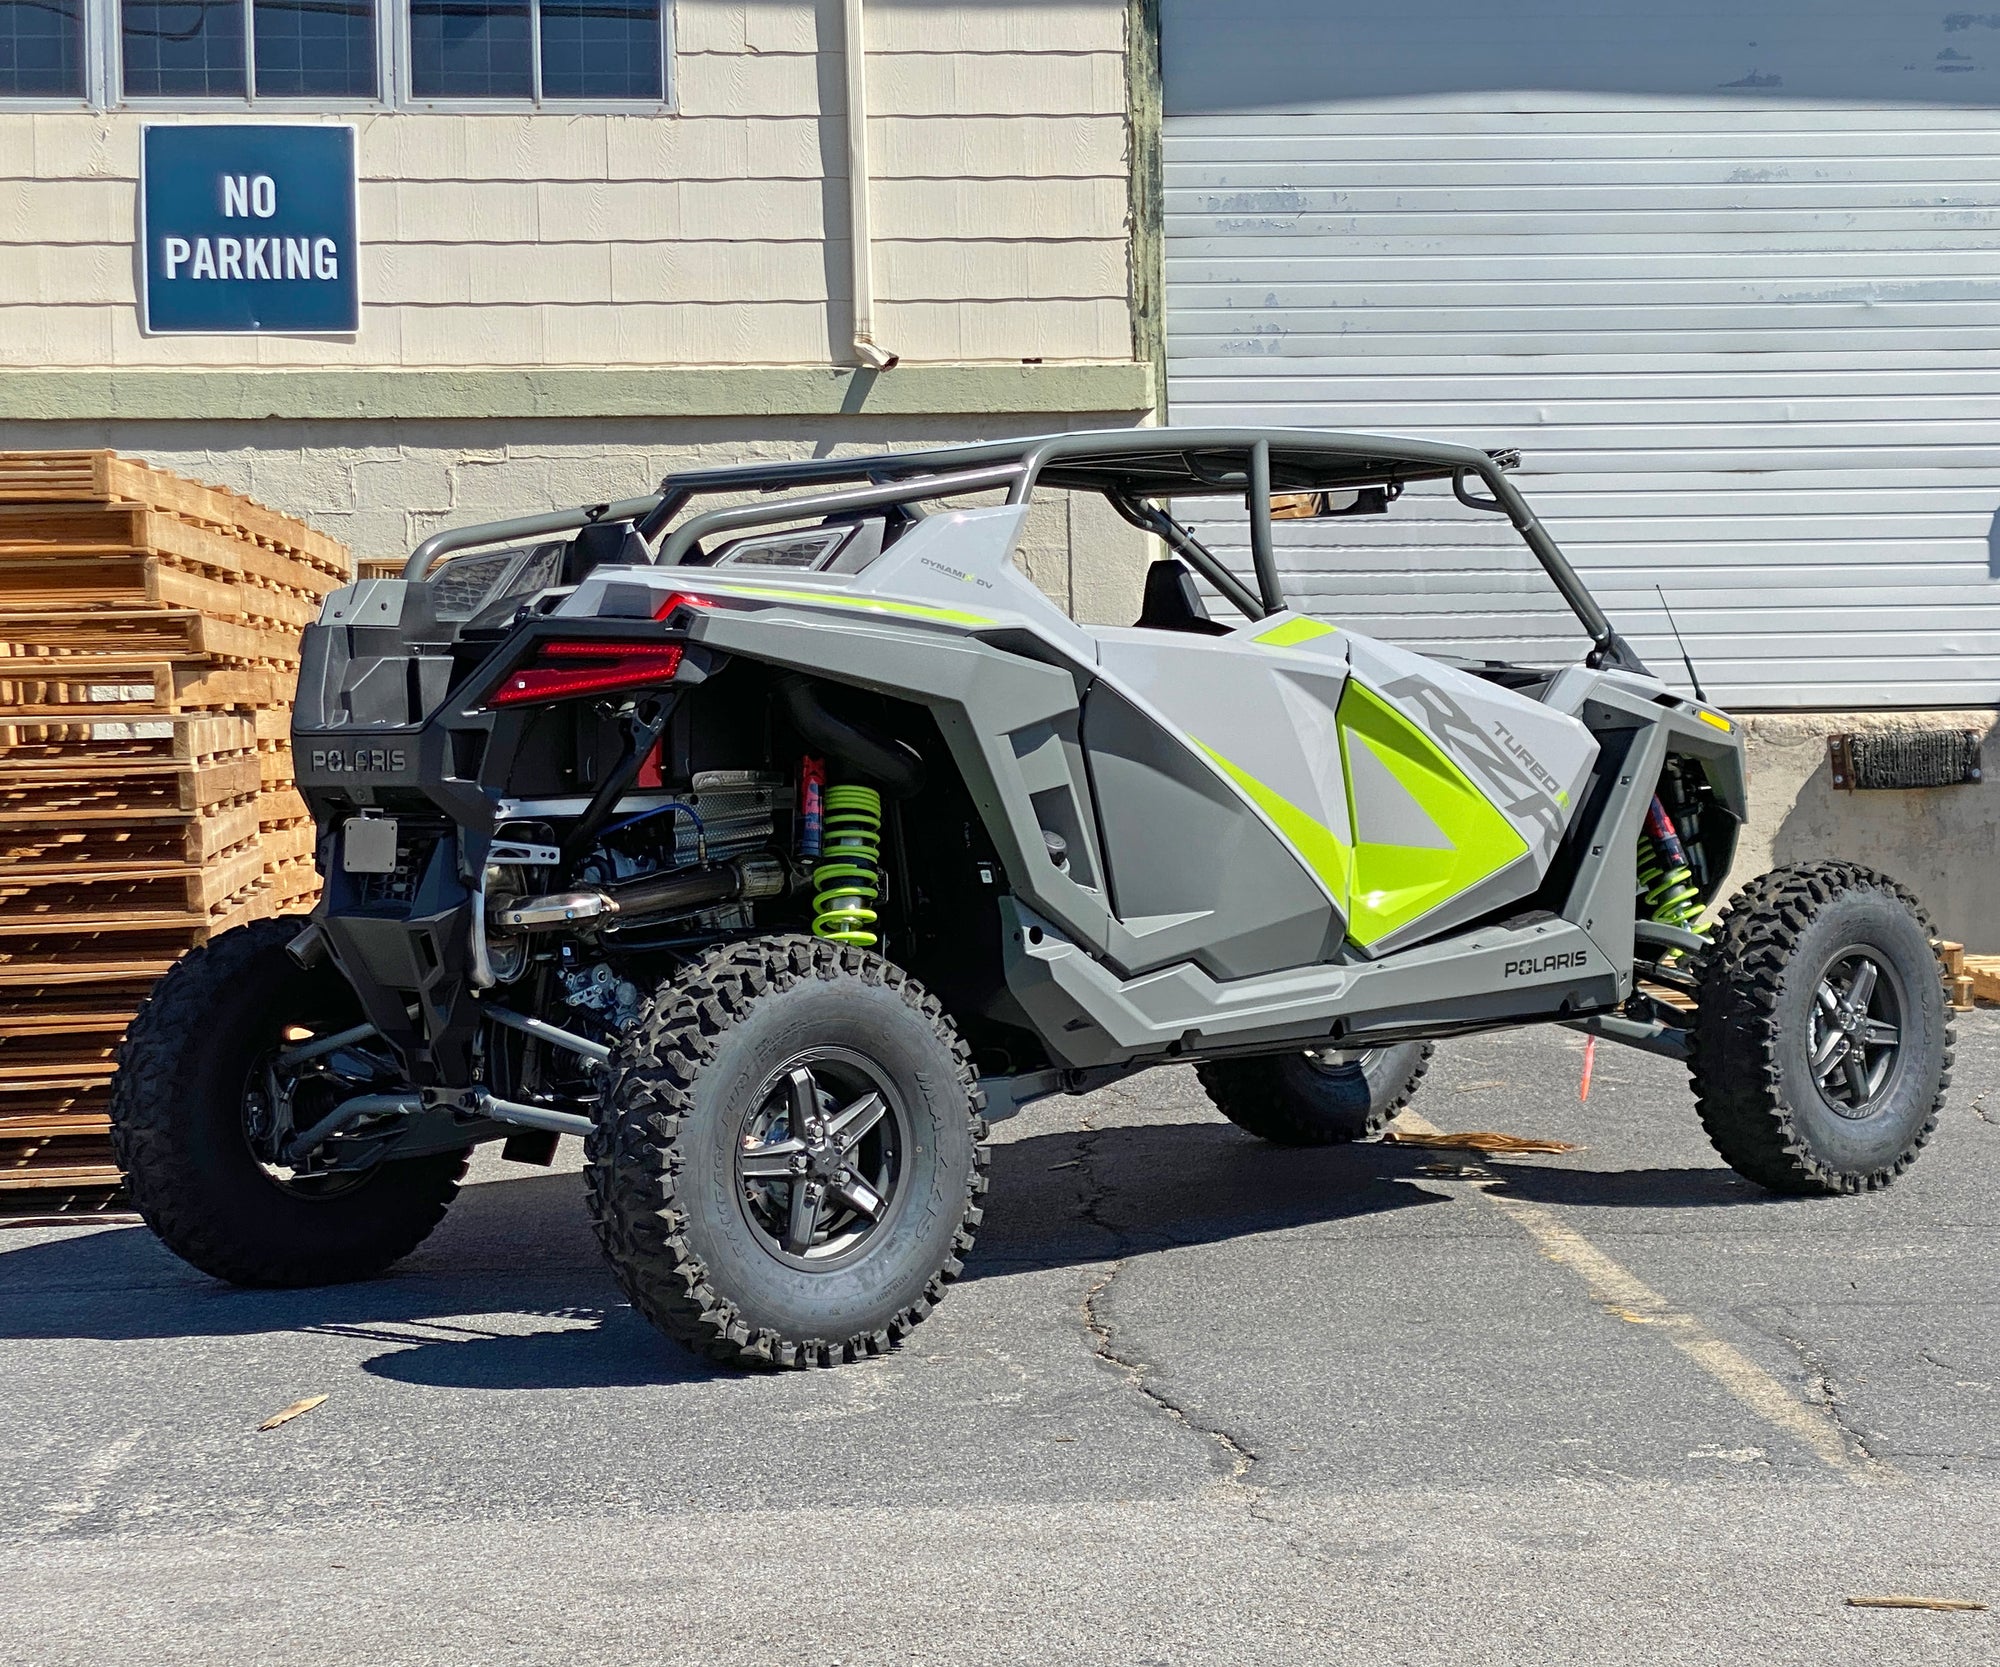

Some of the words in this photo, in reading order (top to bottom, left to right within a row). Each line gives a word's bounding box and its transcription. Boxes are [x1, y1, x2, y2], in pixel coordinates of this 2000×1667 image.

[224, 175, 276, 218] NO
[165, 237, 338, 280] PARKING
[921, 557, 974, 582] DYNAMIX
[976, 579, 993, 589] DV
[312, 750, 406, 772] POLARIS
[1379, 674, 1566, 864] RZR
[1494, 720, 1561, 795] TURBO
[1505, 950, 1588, 978] POLARIS
